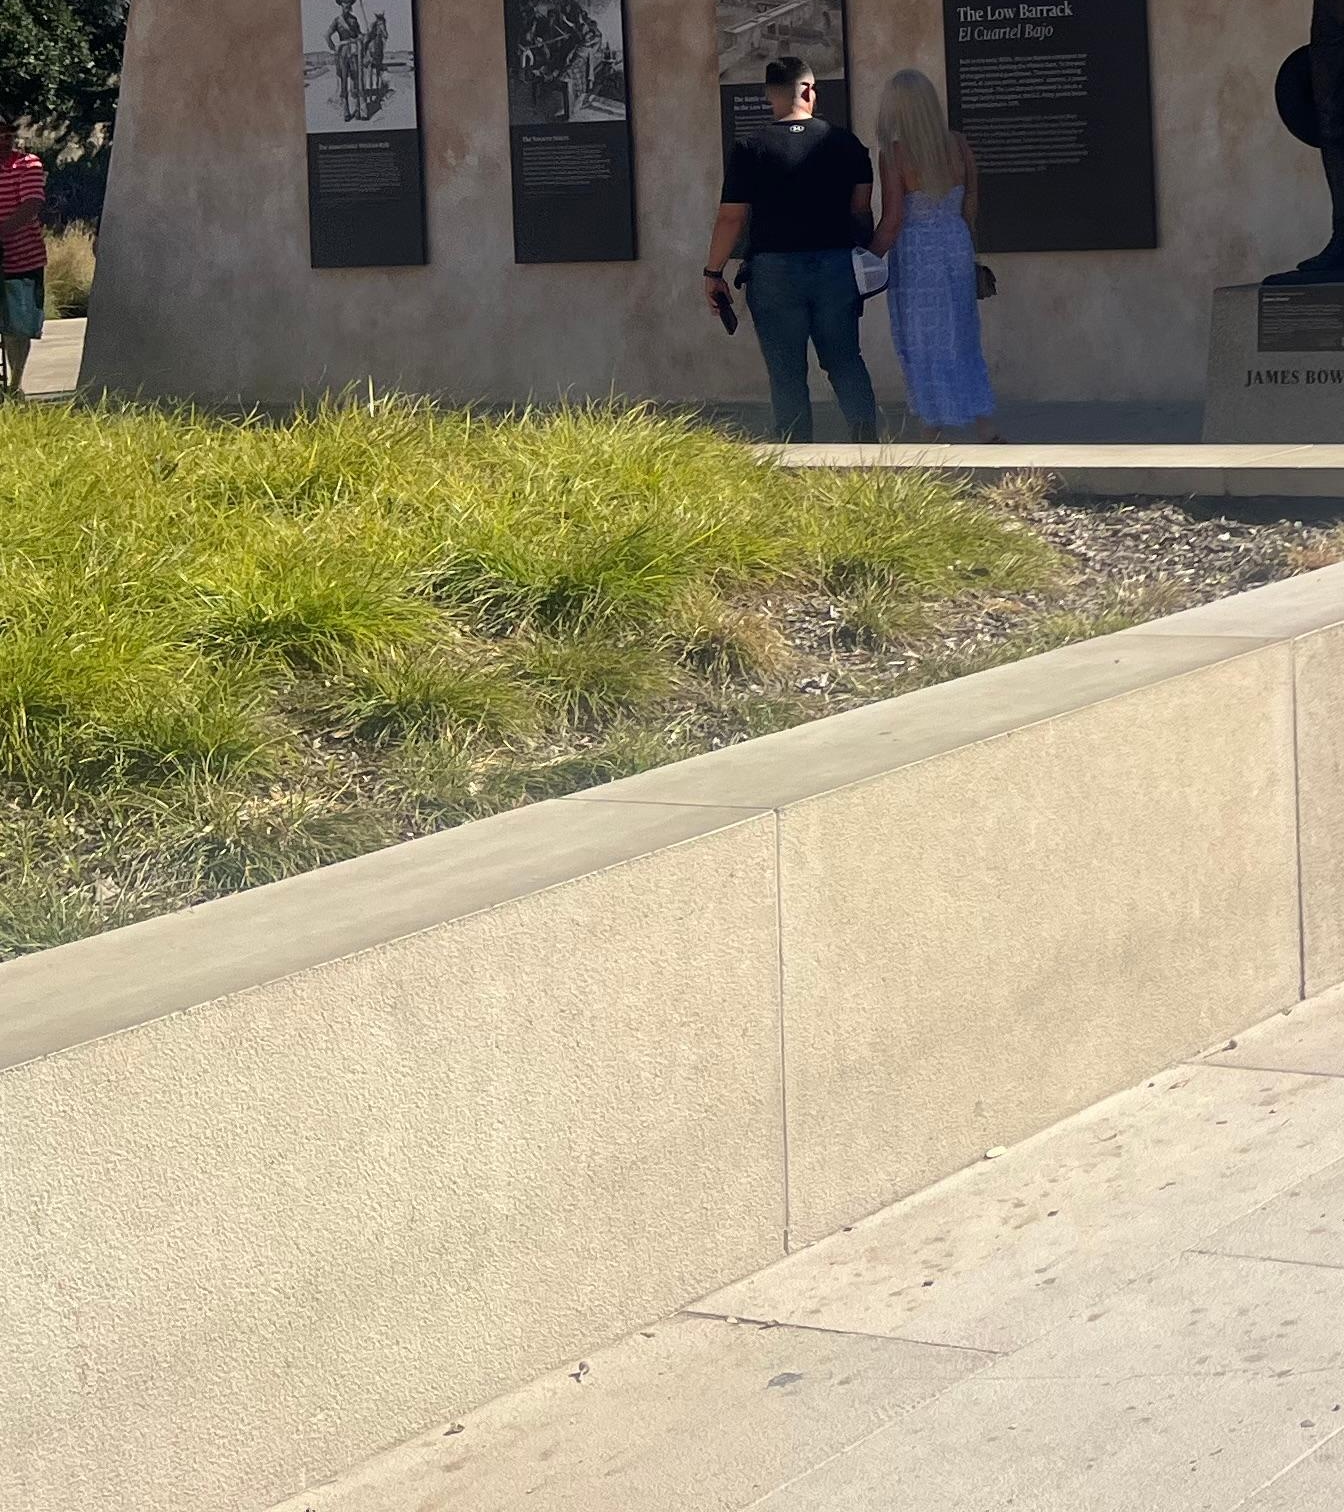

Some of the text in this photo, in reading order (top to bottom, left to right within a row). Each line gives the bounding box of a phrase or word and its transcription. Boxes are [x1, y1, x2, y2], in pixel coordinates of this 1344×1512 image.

[956, 1, 1073, 22] The Low Barrack
[958, 23, 1054, 42] El Cuartel Bajo
[1244, 369, 1300, 388] JAMES
